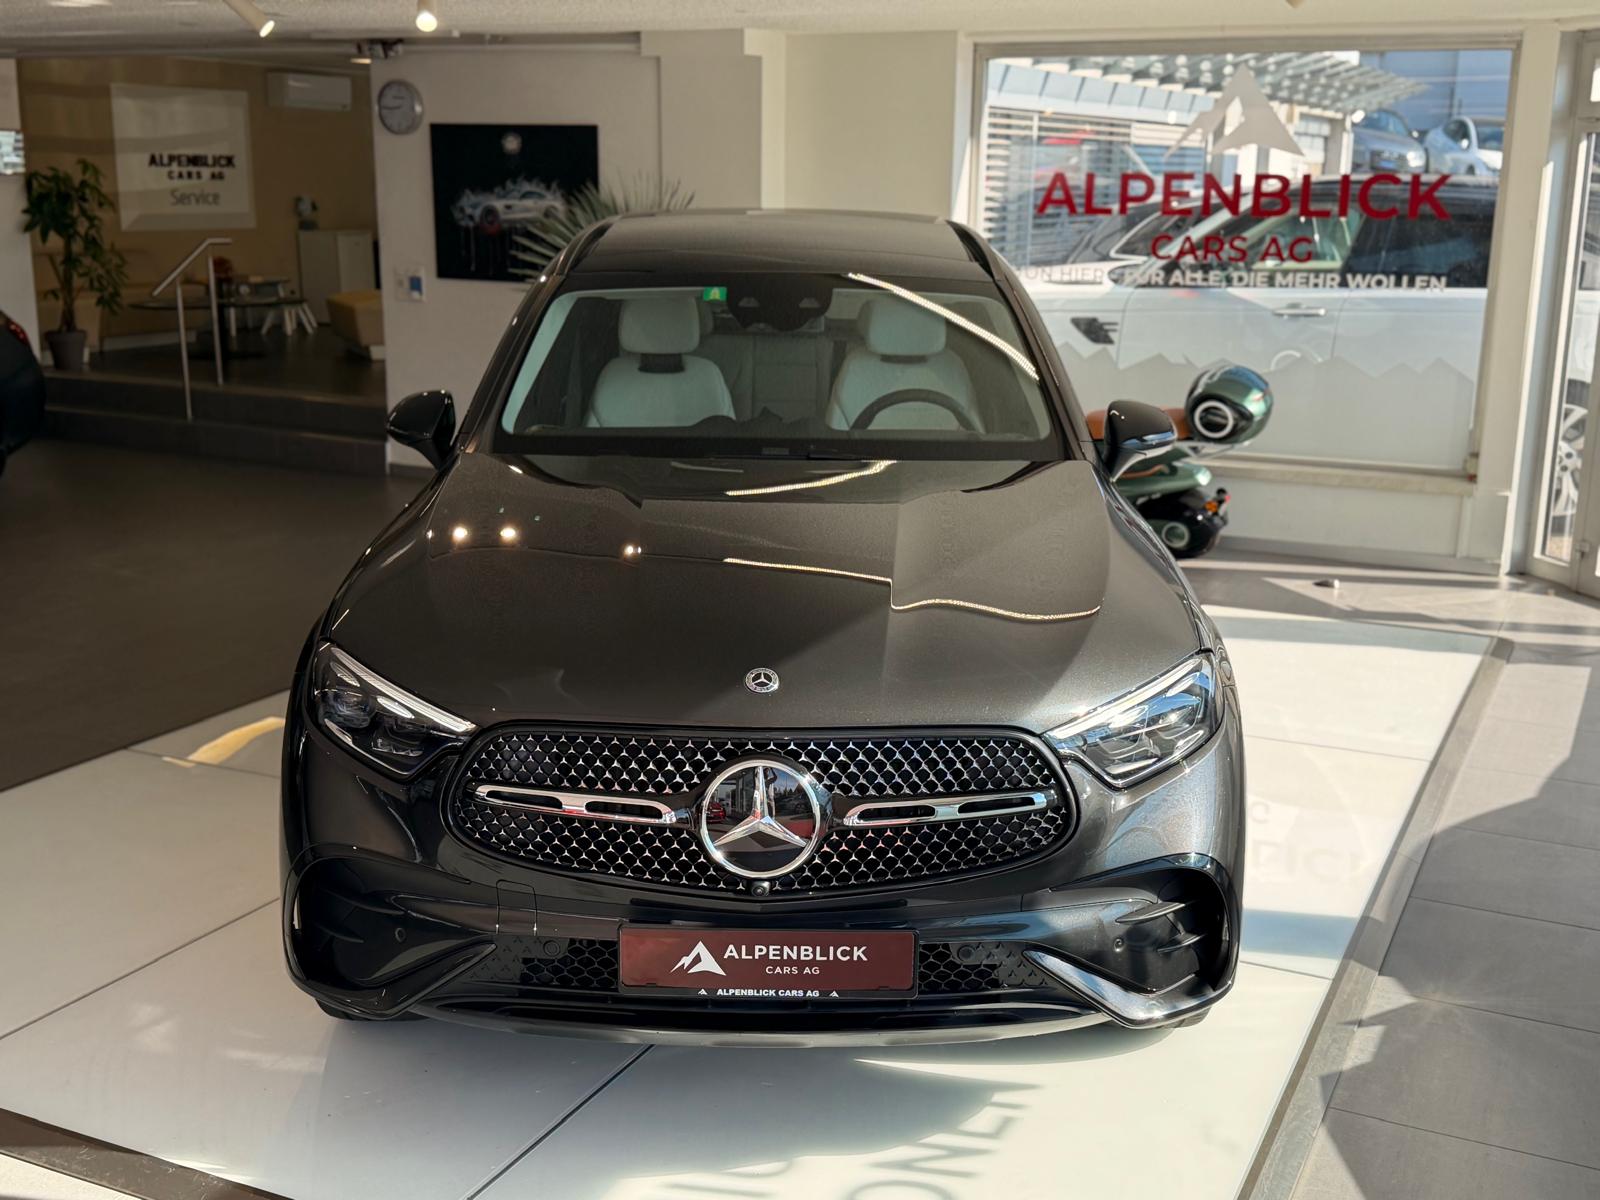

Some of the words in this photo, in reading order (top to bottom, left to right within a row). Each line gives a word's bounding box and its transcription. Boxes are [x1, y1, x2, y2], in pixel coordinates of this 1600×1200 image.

[148, 153, 236, 168] ALPENBLICK
[167, 170, 203, 180] CARS
[210, 171, 225, 181] AG
[169, 188, 220, 206] Service
[1036, 171, 1454, 221] ALPENBLICK
[1151, 234, 1249, 263] CARS
[1259, 236, 1314, 263] AG
[1060, 267, 1104, 282] HIER
[1231, 271, 1269, 288] DIE
[1274, 271, 1341, 289] MEHR
[1345, 273, 1448, 291] WOLLEN
[723, 944, 868, 961] ALPENBLICK
[765, 966, 799, 975] CARS
[803, 966, 820, 975] AG
[716, 988, 776, 997] ALPENBLICK
[778, 989, 804, 998] CARS
[806, 990, 820, 998] AG
